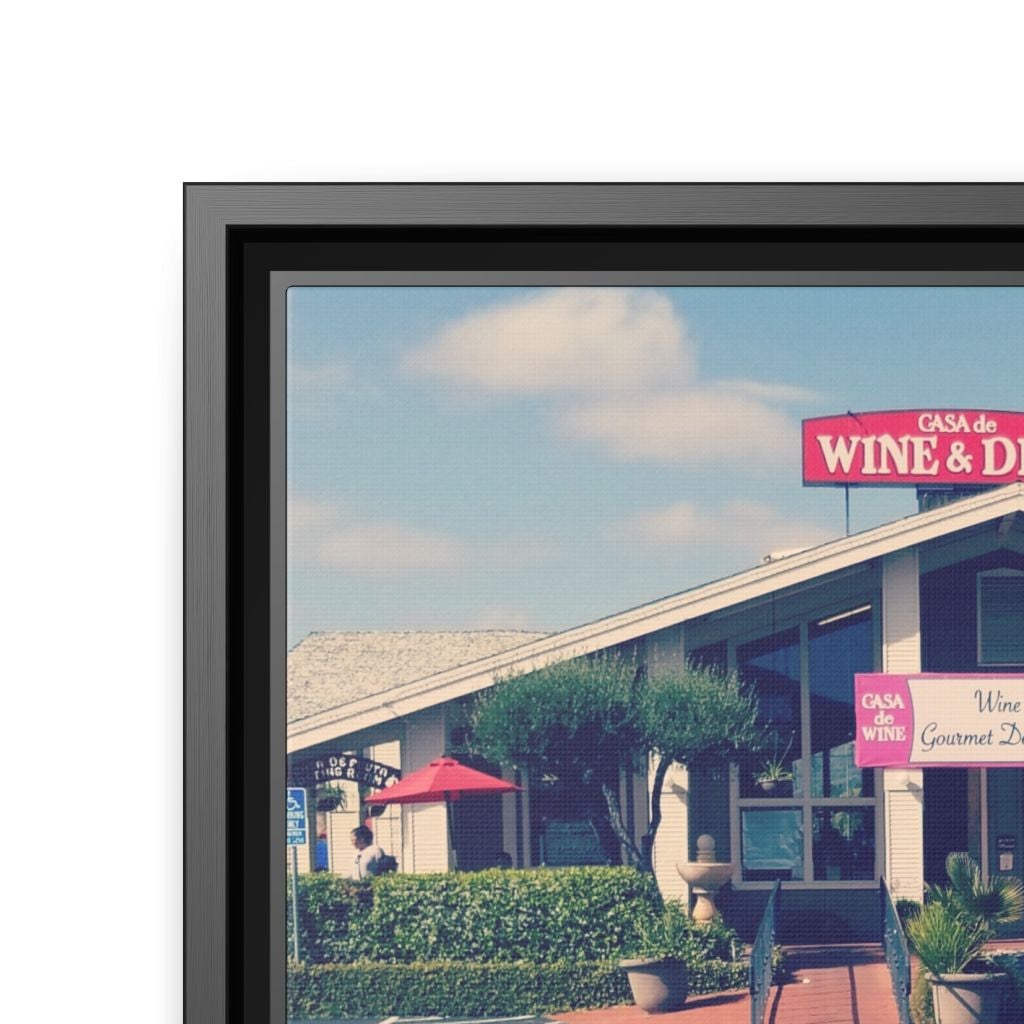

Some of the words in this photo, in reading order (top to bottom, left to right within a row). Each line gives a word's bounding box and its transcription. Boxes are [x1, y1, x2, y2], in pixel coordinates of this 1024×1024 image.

[918, 413, 970, 433] CASA
[973, 413, 997, 433] de
[816, 434, 940, 475] WINE
[946, 441, 973, 473] &
[861, 693, 905, 709] CASA
[974, 689, 1021, 713] Wine
[873, 710, 894, 726] de
[862, 726, 906, 742] WINE
[921, 722, 993, 752] Gourmet
